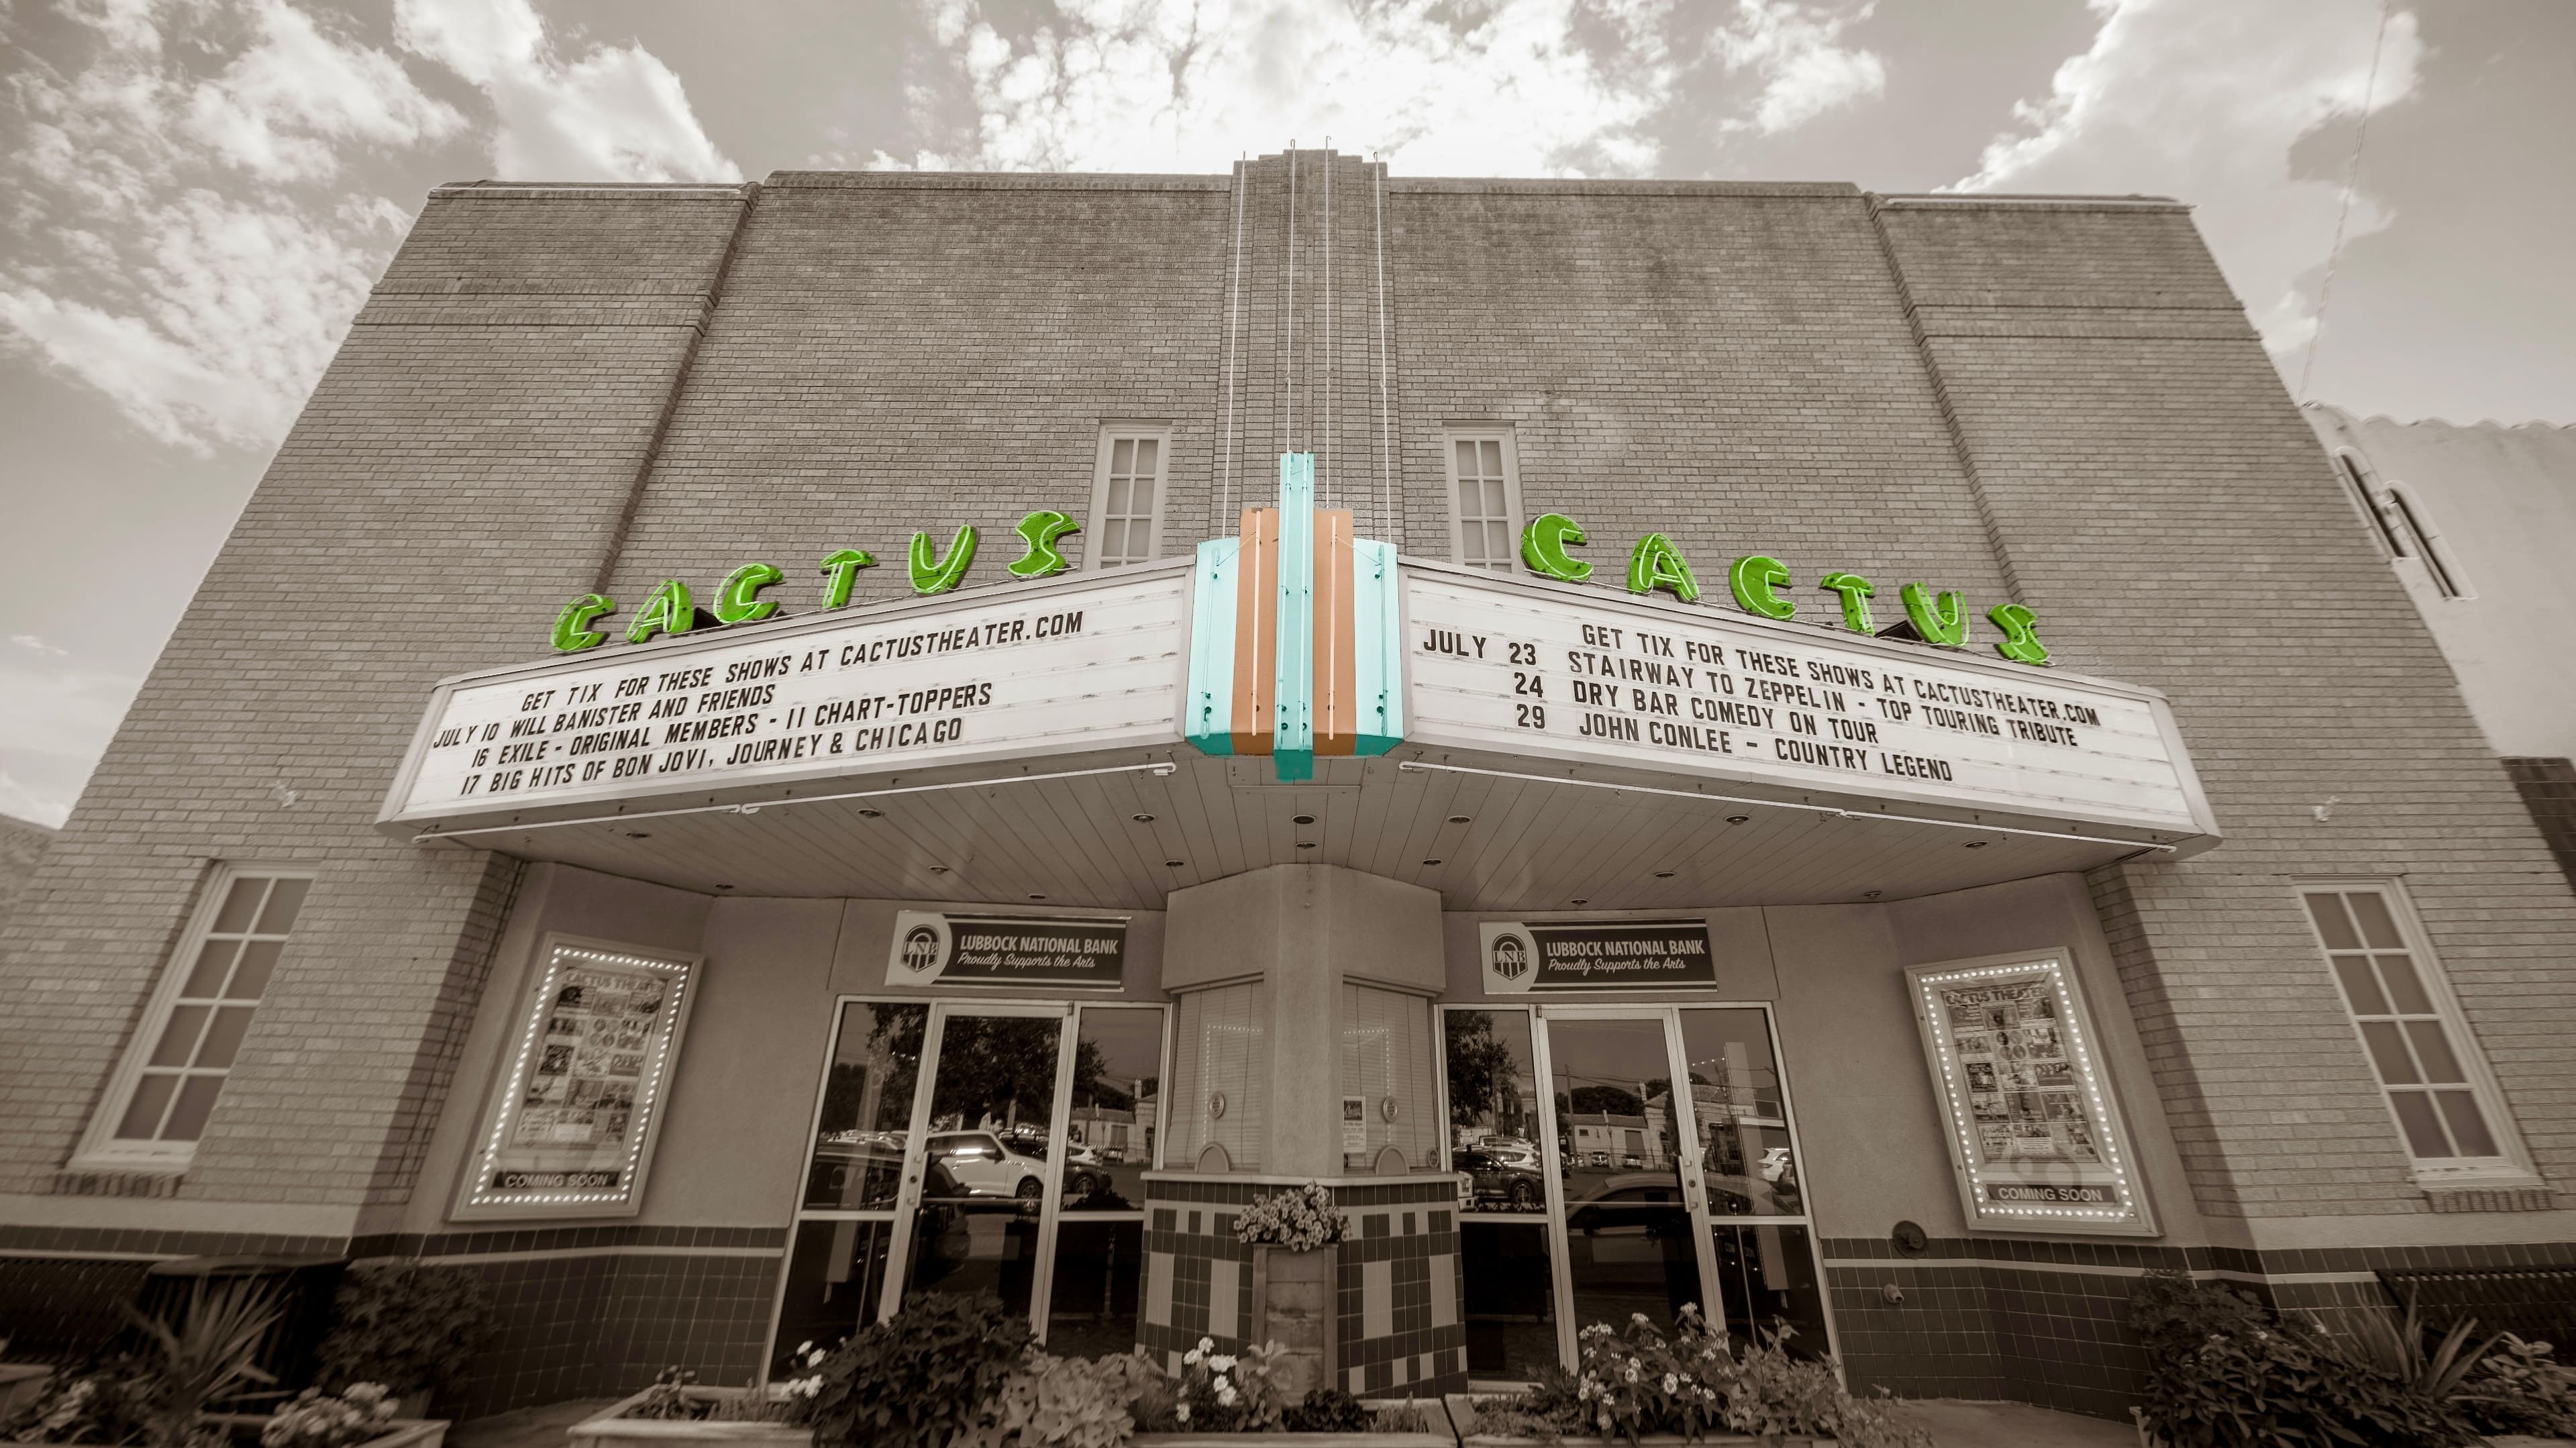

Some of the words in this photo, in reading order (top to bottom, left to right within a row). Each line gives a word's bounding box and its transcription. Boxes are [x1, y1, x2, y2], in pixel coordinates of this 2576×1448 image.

[550, 509, 1082, 653] CACTUS
[1521, 512, 2055, 666] CACTUS
[521, 690, 556, 712] GET
[567, 682, 603, 705] TIX
[615, 676, 650, 699] FOR
[658, 666, 714, 693] THESE
[725, 655, 792, 683] SHOWS
[799, 649, 830, 672] AT
[840, 611, 1083, 666] CACTUSTHEATER.COM
[1423, 629, 1487, 659] JULY
[1508, 642, 1537, 666] 23
[1568, 651, 1694, 688] STAIRWAY
[1706, 671, 1734, 694] TO
[1744, 677, 1846, 713] ZEPPELIN
[1876, 697, 1912, 721] TOP
[1920, 705, 2000, 735] TOURING
[2006, 719, 2078, 747] TRIBUTE
[1582, 624, 1622, 650] GET
[1636, 632, 1675, 658] TIX
[1685, 641, 1725, 666] FOR
[1735, 649, 1800, 678] THESE
[1807, 661, 1874, 690] SHOWS
[1883, 674, 1905, 695] AT
[1913, 679, 2101, 726] CACTUSTHEATER.COM
[433, 725, 478, 749] JULY
[480, 723, 500, 742] 10
[509, 715, 546, 738] WILL
[552, 702, 642, 733] BANISTER
[648, 696, 688, 720] AND
[697, 684, 776, 713] FRIENDS
[471, 747, 489, 768] 16
[498, 740, 550, 765] EXILE
[569, 727, 650, 756] ORIGINAL
[664, 713, 759, 744] MEMBERS
[786, 707, 806, 730] 11
[815, 682, 992, 726] CHART-TOPPERS
[1514, 672, 1544, 699] 24
[1573, 680, 1618, 707] DRY
[1632, 688, 1679, 716] BAR
[1690, 697, 1773, 729] COMEDY
[1789, 711, 1817, 736] ON
[1827, 717, 1879, 744] TOUR
[1516, 703, 1545, 729] 29
[1579, 713, 1640, 741] JOHN
[1649, 721, 1733, 754] CONLEE
[1775, 737, 1868, 771] COUNTRY
[1881, 752, 1953, 782] LEGEND
[461, 774, 481, 795] 17
[489, 770, 523, 792] BIG
[529, 763, 576, 788] HITS
[582, 760, 607, 782] OF
[612, 754, 653, 779] BON
[658, 748, 713, 773] JOVI,
[726, 733, 823, 766] JOURNEY
[829, 732, 843, 754] &
[856, 717, 962, 752] CHICAGO
[957, 952, 1002, 972] Proudly
[1004, 953, 1051, 971] Supports
[1054, 954, 1070, 967] the
[1072, 955, 1095, 968] Arts
[960, 935, 1018, 952] LUBBOCK
[1019, 937, 1081, 953] NATIONAL
[1084, 939, 1118, 955] BANK
[1494, 950, 1526, 963] LNB
[1547, 941, 1603, 958] LUBBOCK
[1605, 940, 1667, 956] NATIONAL
[1670, 939, 1705, 955] BANK
[1548, 958, 1591, 976] Proudly
[1593, 957, 1641, 974] Supports
[1643, 957, 1660, 970] the
[1663, 956, 1686, 970] Arts
[505, 1174, 564, 1188] COMING
[567, 1174, 609, 1187] SOON
[1998, 1187, 2055, 1201] COMING
[2059, 1188, 2103, 1202] SOON
